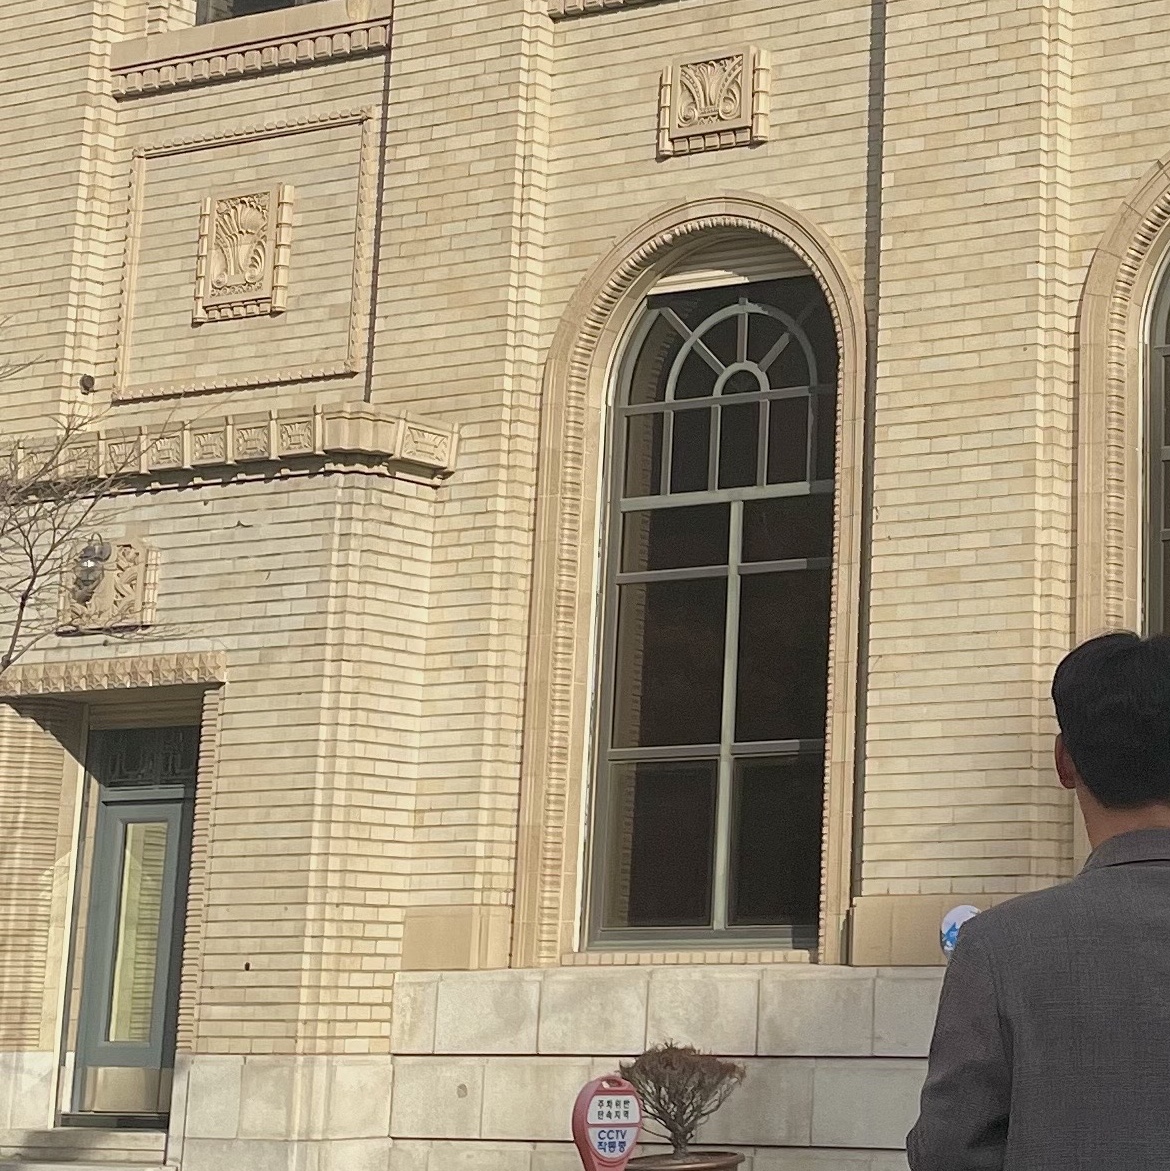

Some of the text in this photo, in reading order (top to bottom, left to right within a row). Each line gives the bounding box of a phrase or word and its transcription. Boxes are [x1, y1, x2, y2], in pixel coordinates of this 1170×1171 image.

[597, 1099, 630, 1109] 주차위반
[597, 1110, 629, 1120] 단속지역
[597, 1129, 627, 1140] CCTV
[597, 1141, 627, 1153] 작동중
